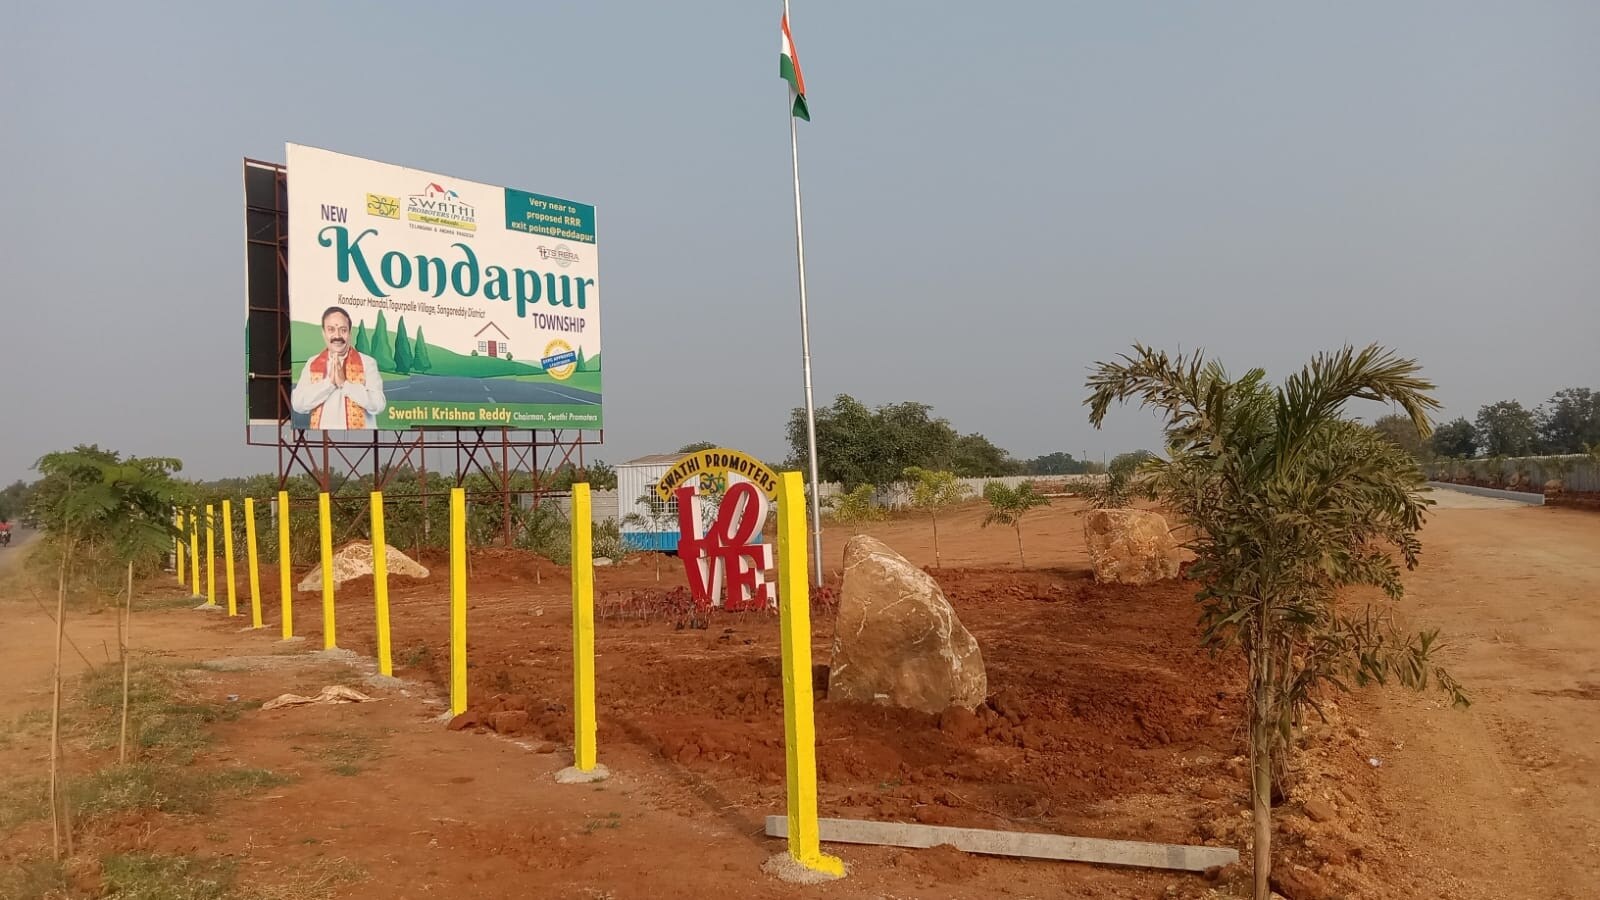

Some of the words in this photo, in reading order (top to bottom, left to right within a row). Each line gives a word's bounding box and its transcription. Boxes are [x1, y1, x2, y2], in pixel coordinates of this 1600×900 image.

[321, 204, 348, 223] NEW
[407, 206, 450, 219] PROMOTERS
[408, 197, 475, 217] SWATHI
[528, 197, 547, 209] Very
[549, 201, 566, 211] near
[568, 206, 576, 214] to
[526, 211, 562, 223] proposed
[564, 215, 581, 227] RRR
[511, 221, 528, 231] exit
[528, 224, 594, 242] point@Peddapur
[317, 225, 595, 318] Kondapur
[337, 294, 366, 308] Kondapur
[532, 312, 586, 333] TOWNSHIP
[388, 406, 428, 420] Swathi
[432, 407, 475, 421] Krishna
[479, 408, 511, 423] Reddy
[513, 411, 546, 421] Chairman,
[547, 412, 568, 421] Swathi
[569, 412, 598, 421] Promoters
[660, 456, 700, 495] SWATHI
[704, 453, 777, 492] PROMOTERS
